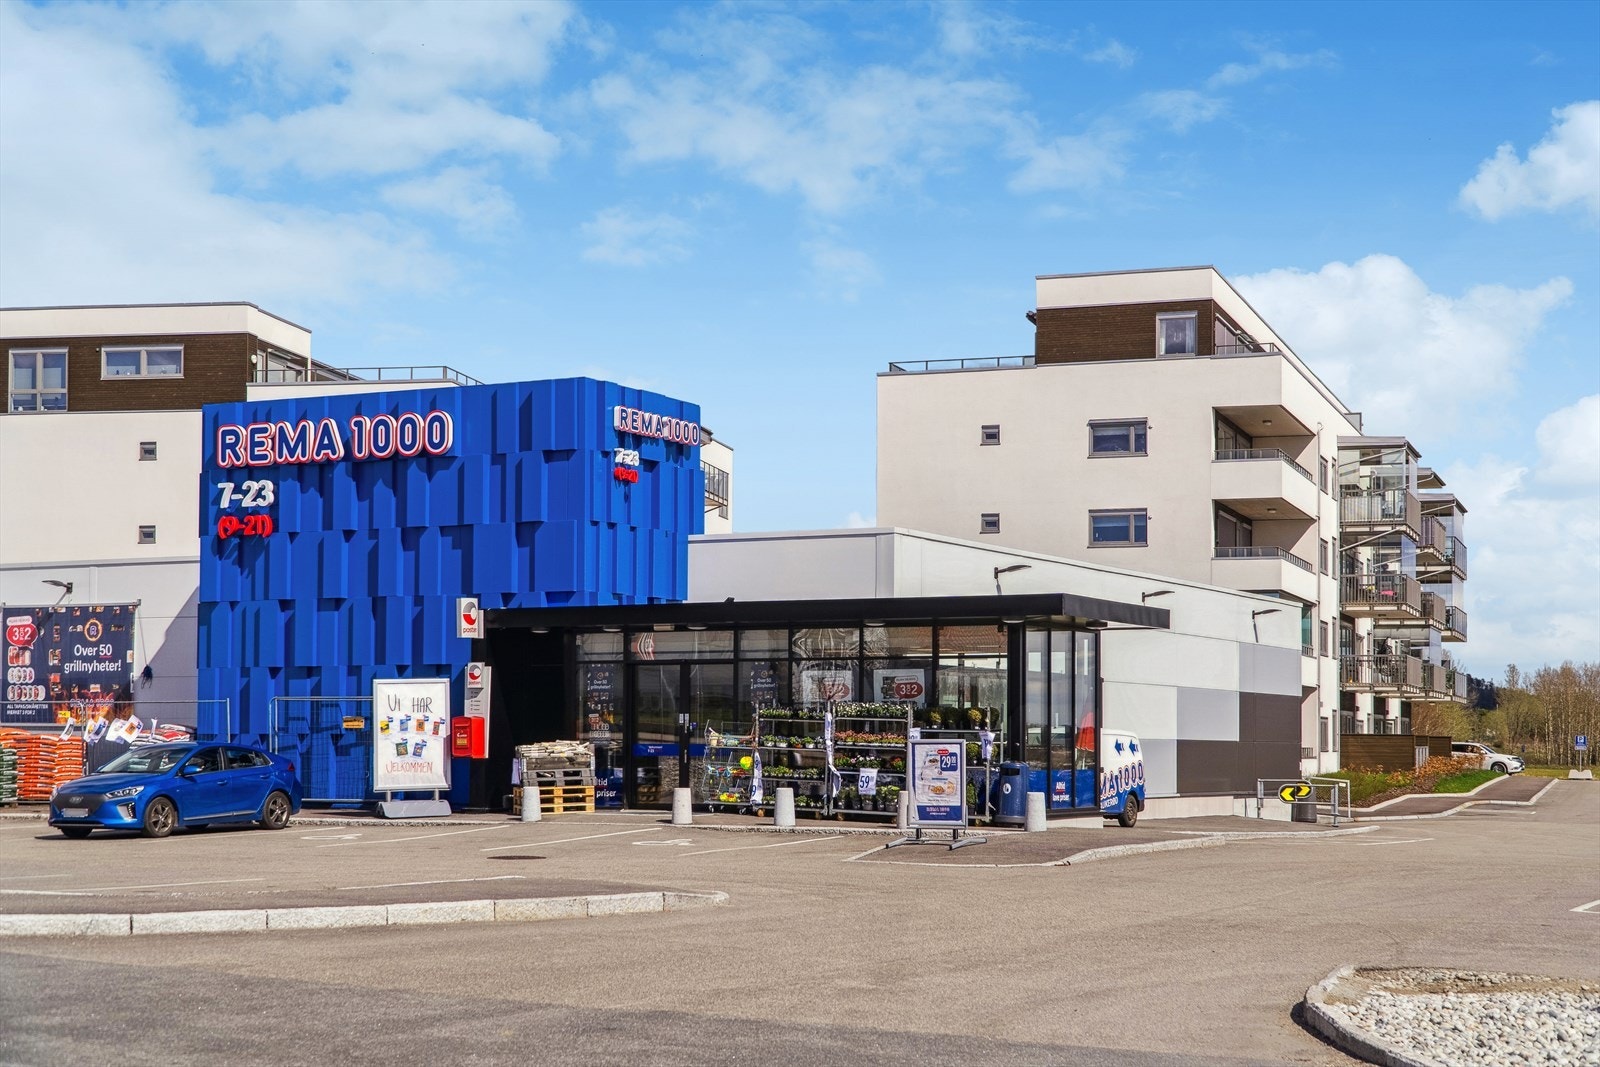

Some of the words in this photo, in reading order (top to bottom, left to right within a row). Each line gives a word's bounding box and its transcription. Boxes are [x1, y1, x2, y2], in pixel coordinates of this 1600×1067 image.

[614, 405, 663, 439] REMA
[662, 416, 700, 446] 1000
[217, 417, 344, 468] REMA
[350, 409, 453, 460] 1000
[217, 479, 274, 508] 7-23
[217, 514, 273, 539] (9-21)
[12, 627, 20, 641] 3
[24, 627, 31, 641] 2
[74, 644, 98, 656] Over
[99, 644, 112, 657] 50
[64, 659, 121, 674] grillnyheter!
[900, 684, 906, 695] 3
[911, 684, 918, 695] 2
[411, 697, 433, 713] HAR
[941, 755, 951, 768] 29
[859, 775, 870, 788] 59
[1117, 759, 1144, 793] 1000
[596, 789, 616, 798] priser
